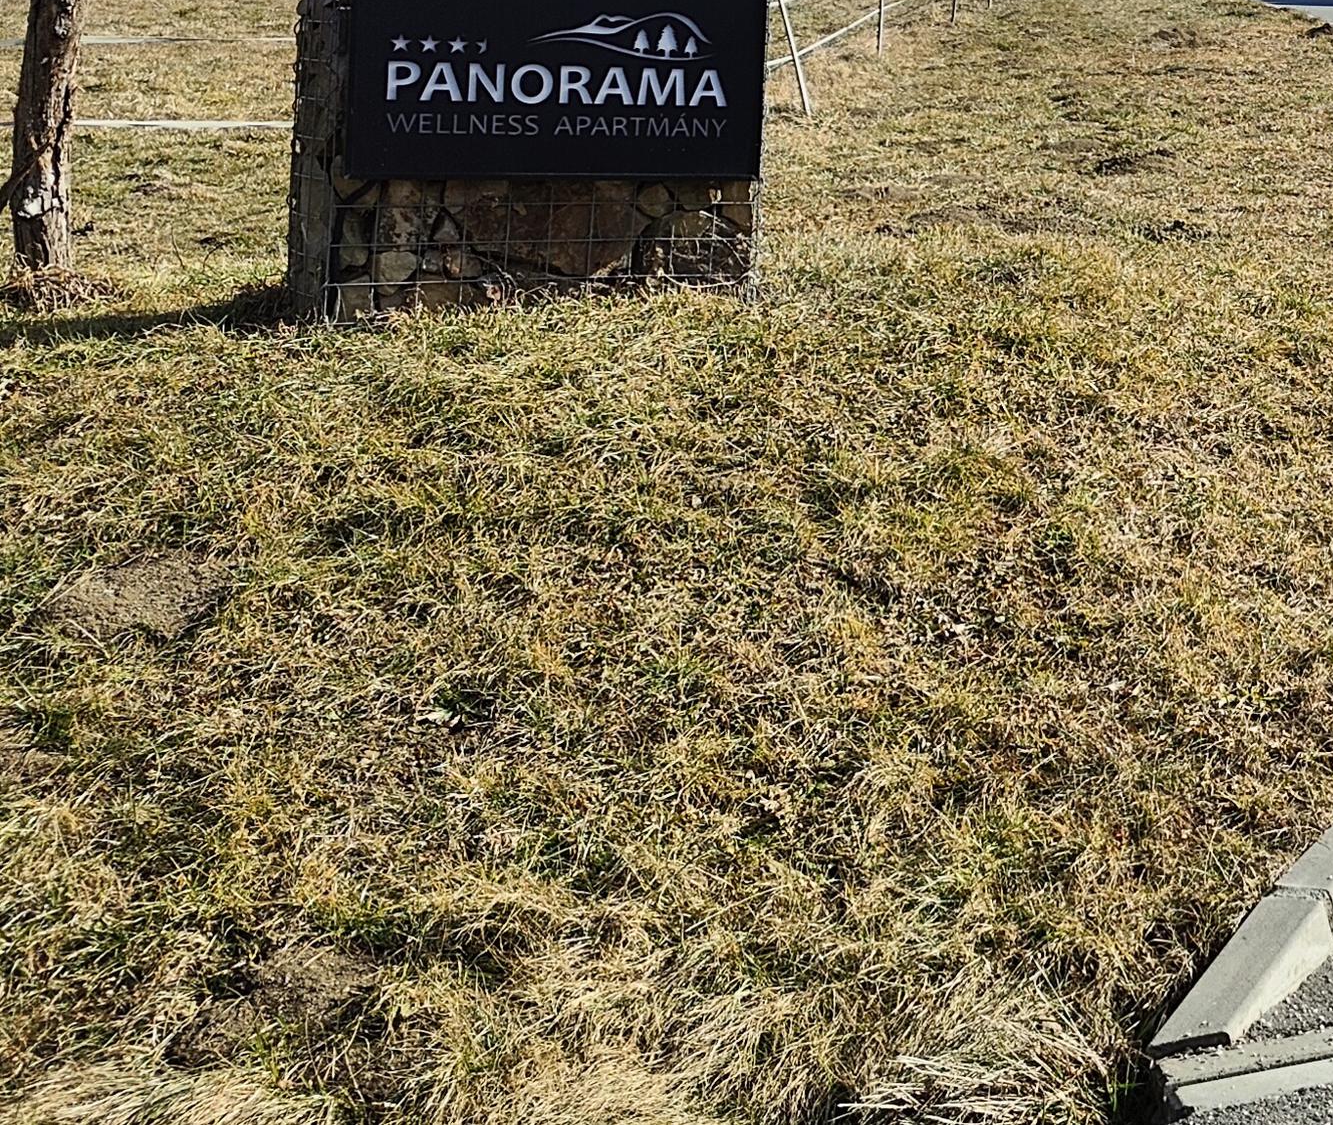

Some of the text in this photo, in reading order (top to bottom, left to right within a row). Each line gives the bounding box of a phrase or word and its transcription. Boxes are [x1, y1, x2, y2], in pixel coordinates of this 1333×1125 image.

[386, 60, 728, 107] PANORAMA
[387, 113, 727, 138] WELLNESS APARTMÁNY
